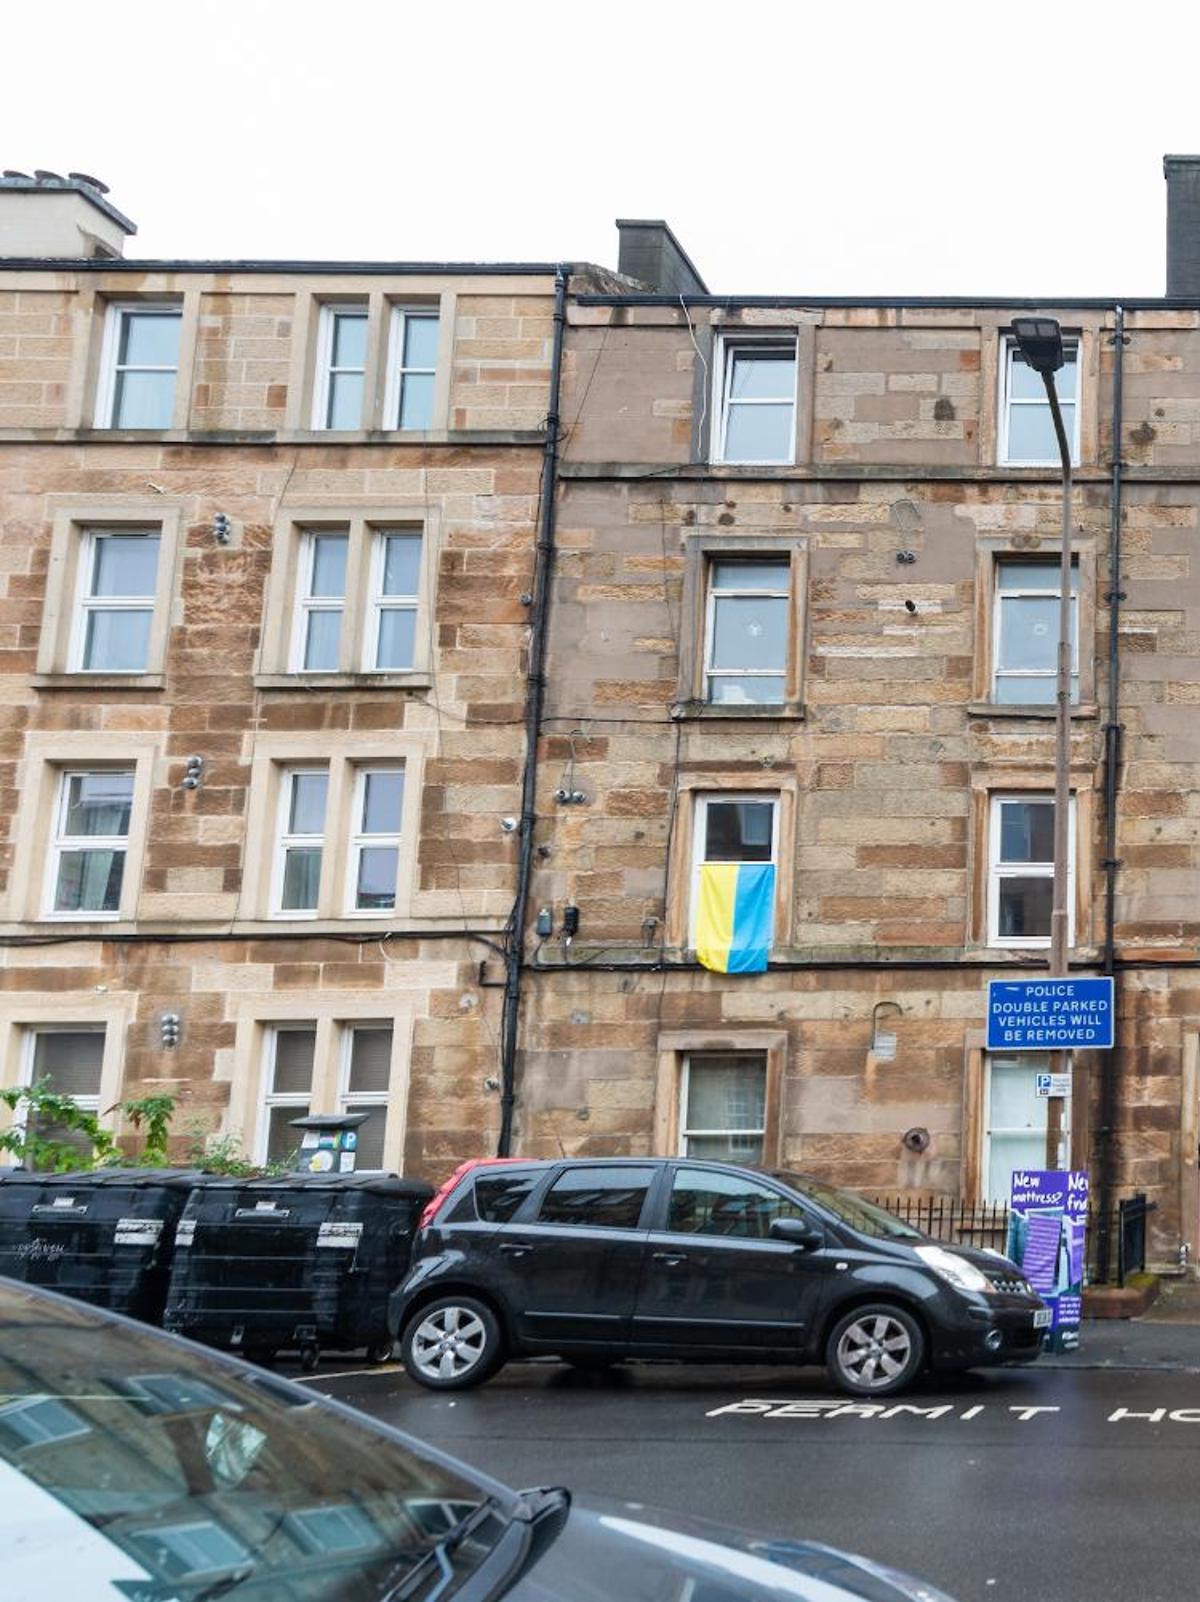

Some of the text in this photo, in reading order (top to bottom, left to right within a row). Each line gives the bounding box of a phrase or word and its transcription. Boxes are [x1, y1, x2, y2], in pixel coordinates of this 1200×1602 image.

[1026, 985, 1075, 997] POLICE
[993, 1000, 1108, 1014] DOUBLE PARKED
[998, 1014, 1102, 1027] VEHICLES WILL
[1004, 1029, 1095, 1041] BE REMOVED
[346, 1132, 357, 1149] P
[1013, 1172, 1040, 1189] New
[1012, 1191, 1063, 1205] mattress?
[705, 1402, 1061, 1420] PERMIT
